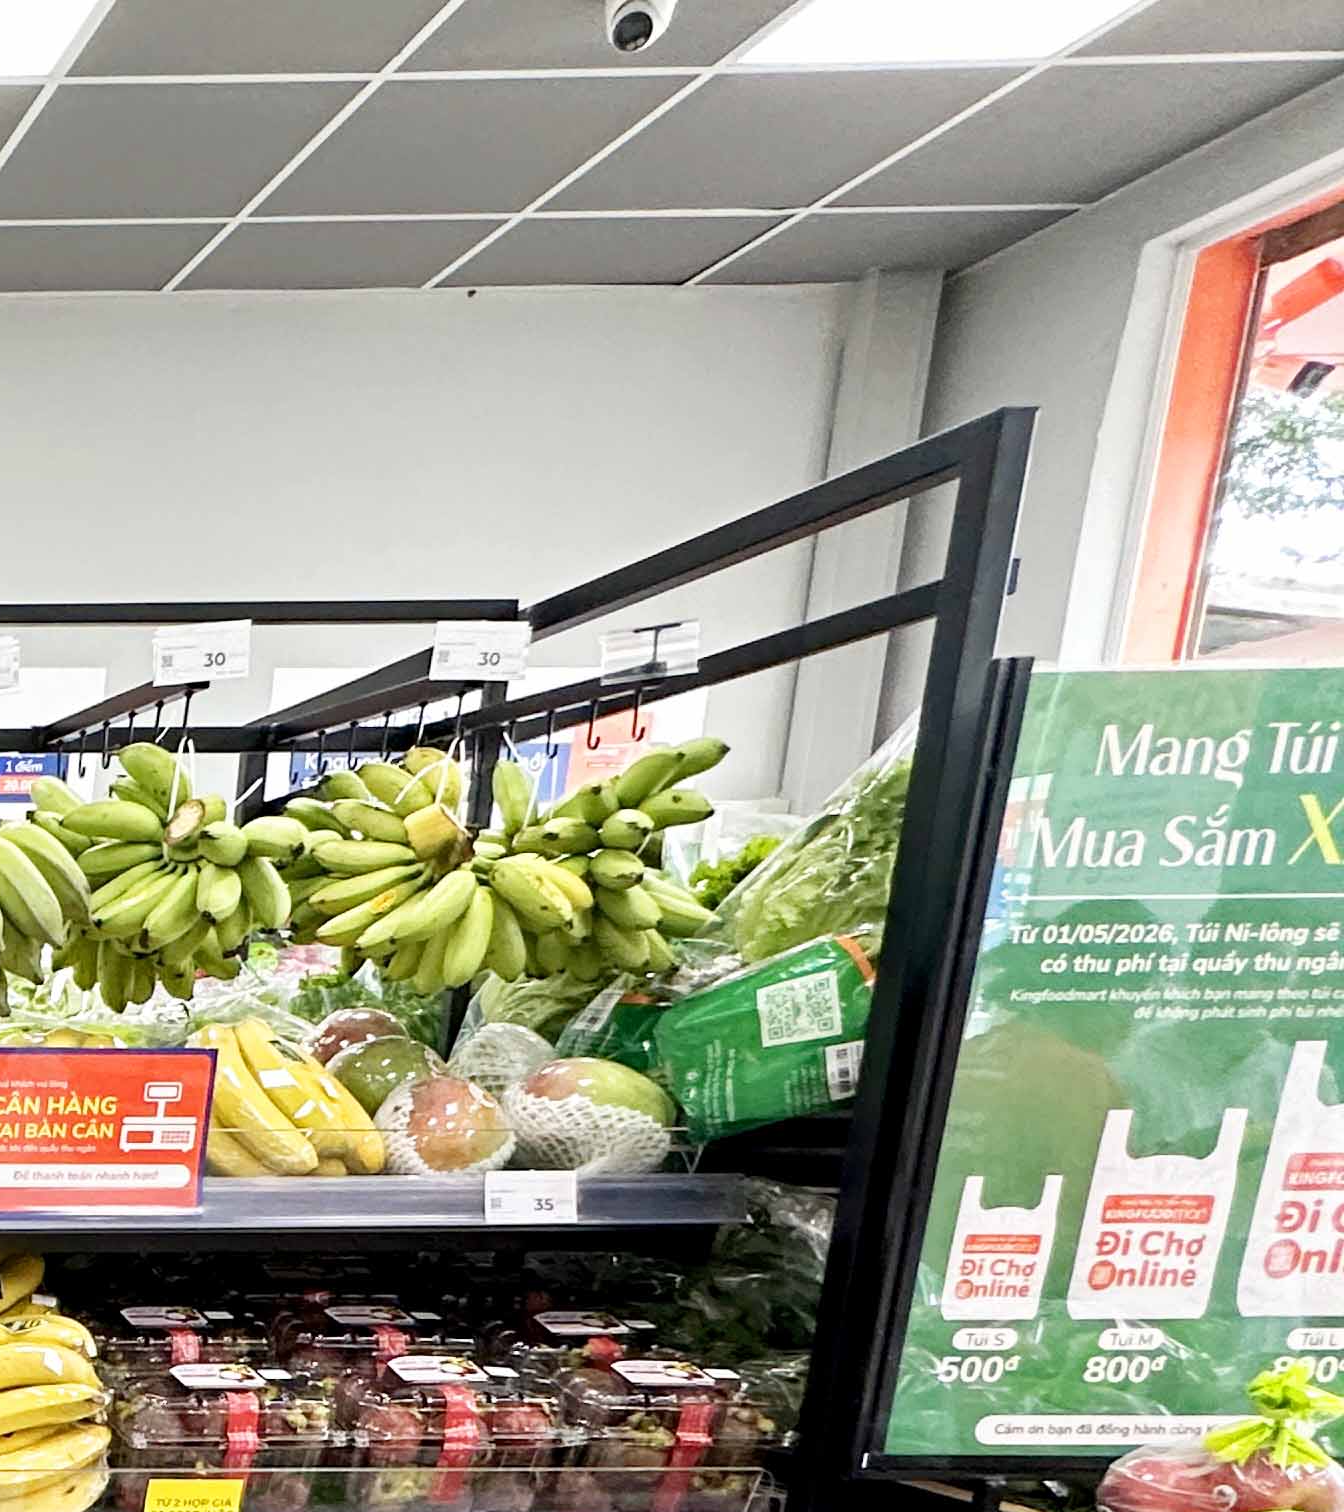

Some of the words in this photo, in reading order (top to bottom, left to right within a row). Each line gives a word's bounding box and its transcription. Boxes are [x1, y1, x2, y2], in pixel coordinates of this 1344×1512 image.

[203, 652, 226, 667] 30
[477, 652, 500, 666] 30
[1095, 724, 1252, 789] Mang
[1268, 720, 1341, 774] Túi
[1029, 817, 1145, 868] Mua
[1159, 805, 1276, 867] Sắm
[1010, 924, 1037, 944] Từ
[1043, 923, 1179, 945] 01/05/2026,
[1186, 923, 1219, 943] Túi
[1224, 922, 1309, 946] Ni-lông
[1041, 953, 1068, 974] có
[1073, 954, 1110, 974] thu
[1115, 952, 1152, 976] phí
[1254, 954, 1291, 972] thu
[47, 1091, 117, 1116] HÀNG
[25, 1119, 68, 1139] BÀN
[72, 1120, 115, 1139] CÂN
[534, 1198, 554, 1211] 35
[1097, 1229, 1133, 1256] Đi
[1140, 1230, 1207, 1265] Chợ
[960, 1258, 984, 1277] Đi
[990, 1258, 1035, 1286] Chợ
[1088, 1260, 1197, 1290] Online
[995, 1332, 1005, 1347] S
[1138, 1332, 1155, 1347] M
